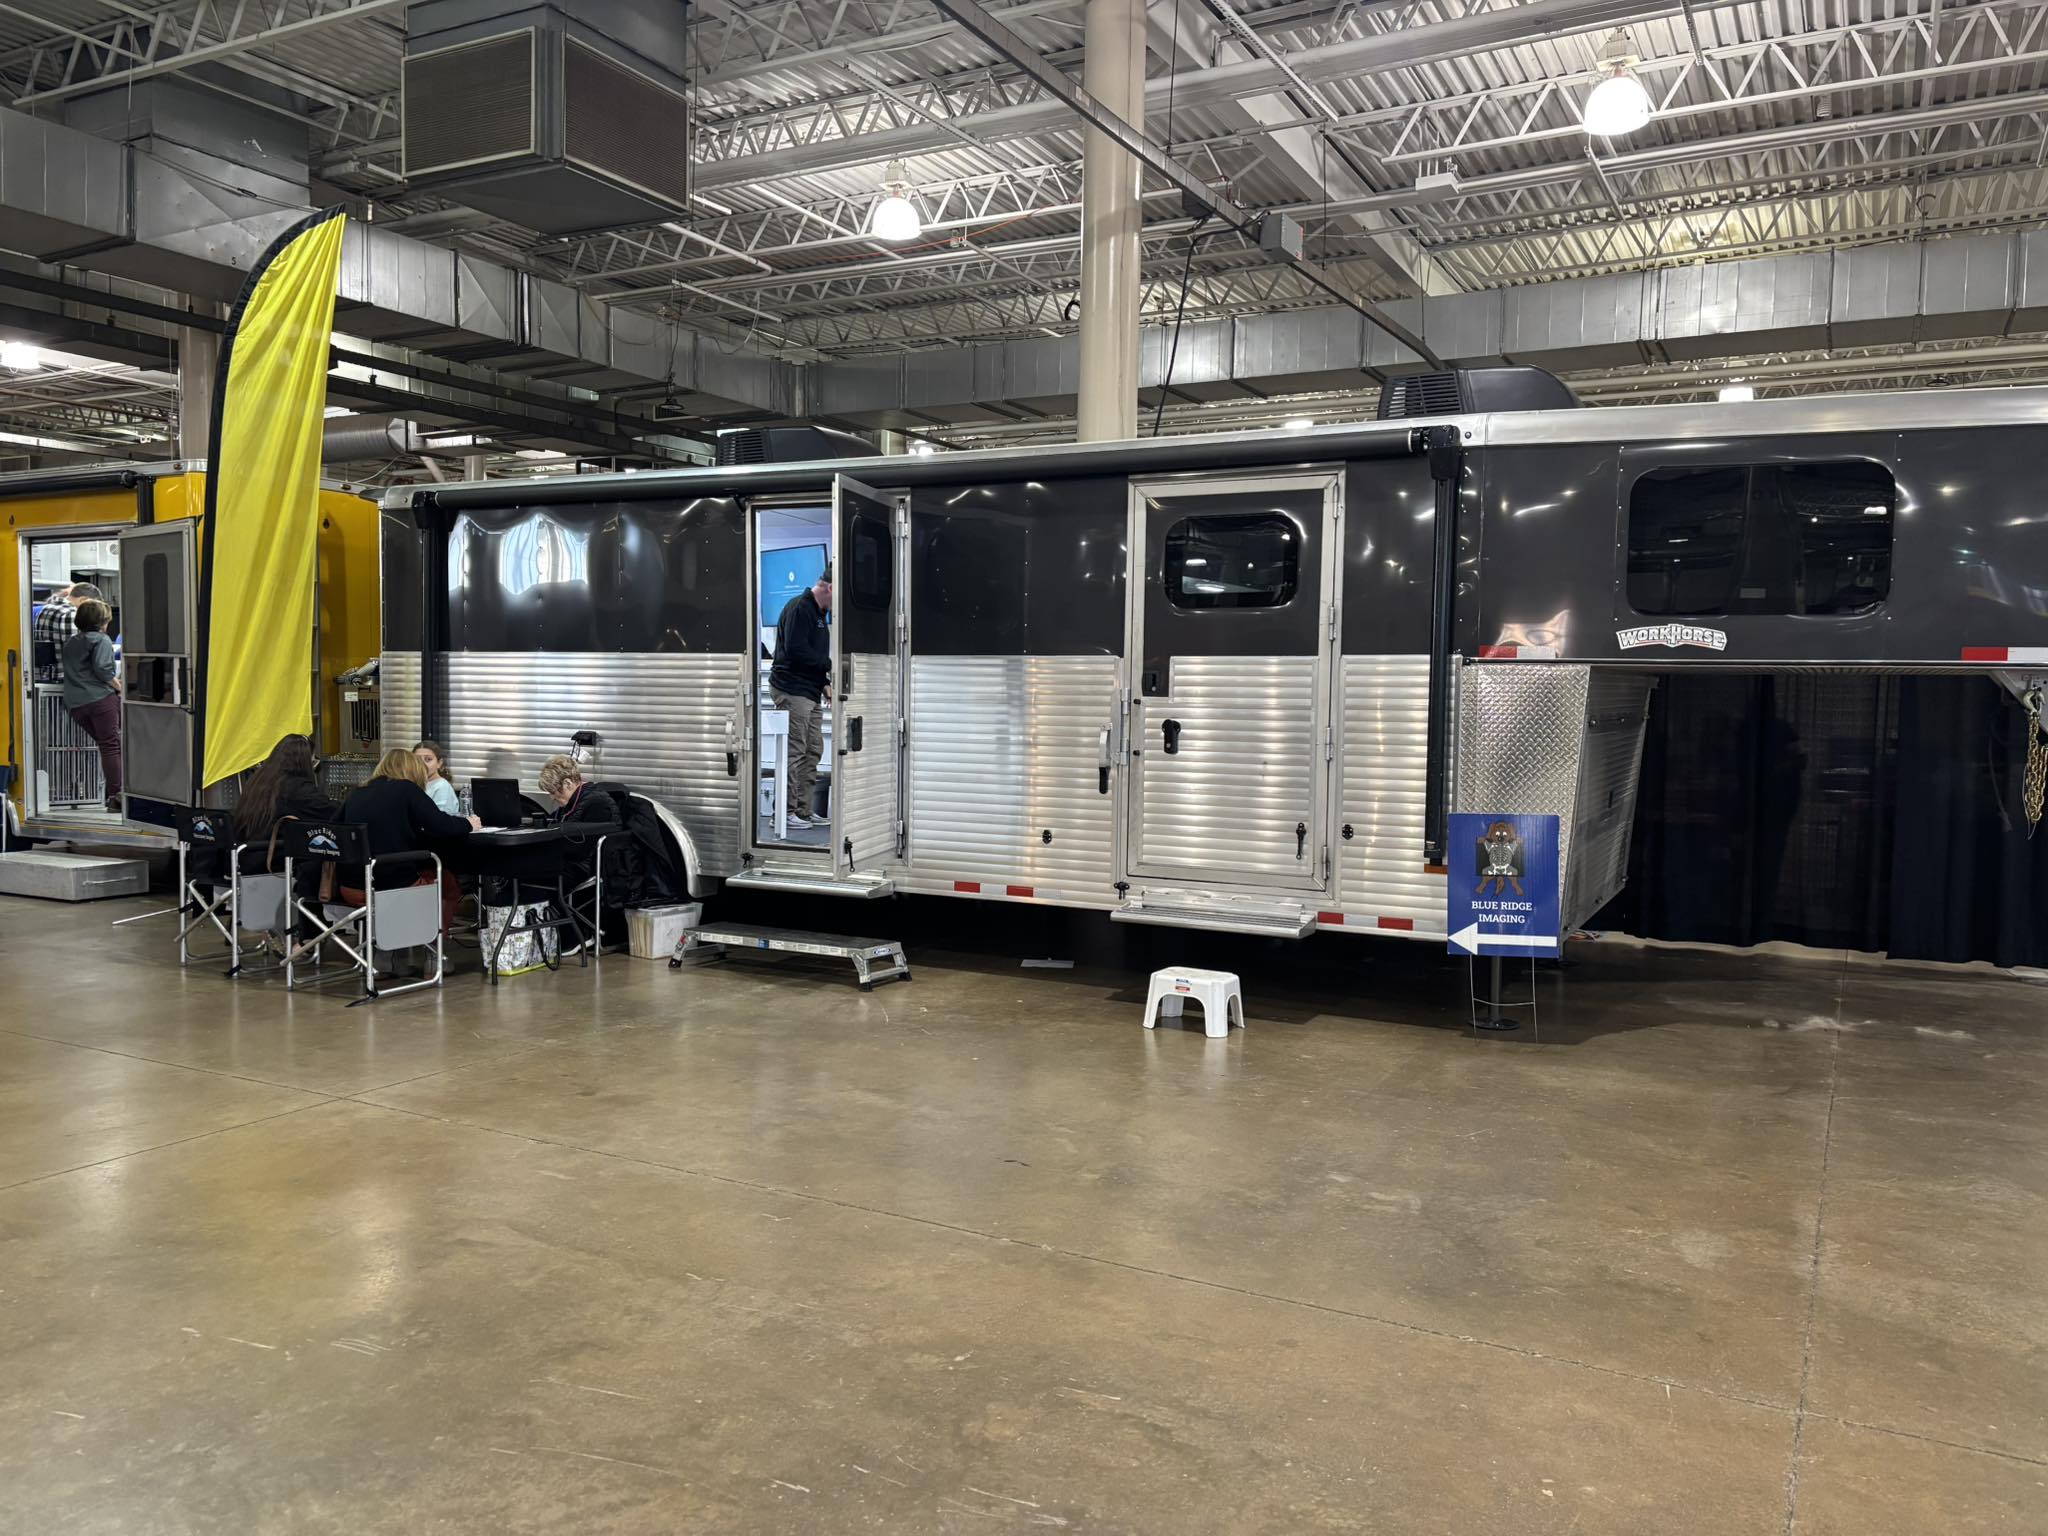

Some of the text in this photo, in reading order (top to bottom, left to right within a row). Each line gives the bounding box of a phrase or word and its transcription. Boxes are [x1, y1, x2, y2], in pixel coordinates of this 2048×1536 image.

[1620, 625, 1725, 648] WORKHORSE
[1471, 901, 1533, 911] BLUE RIDGE
[1478, 913, 1526, 923] IMAGING
